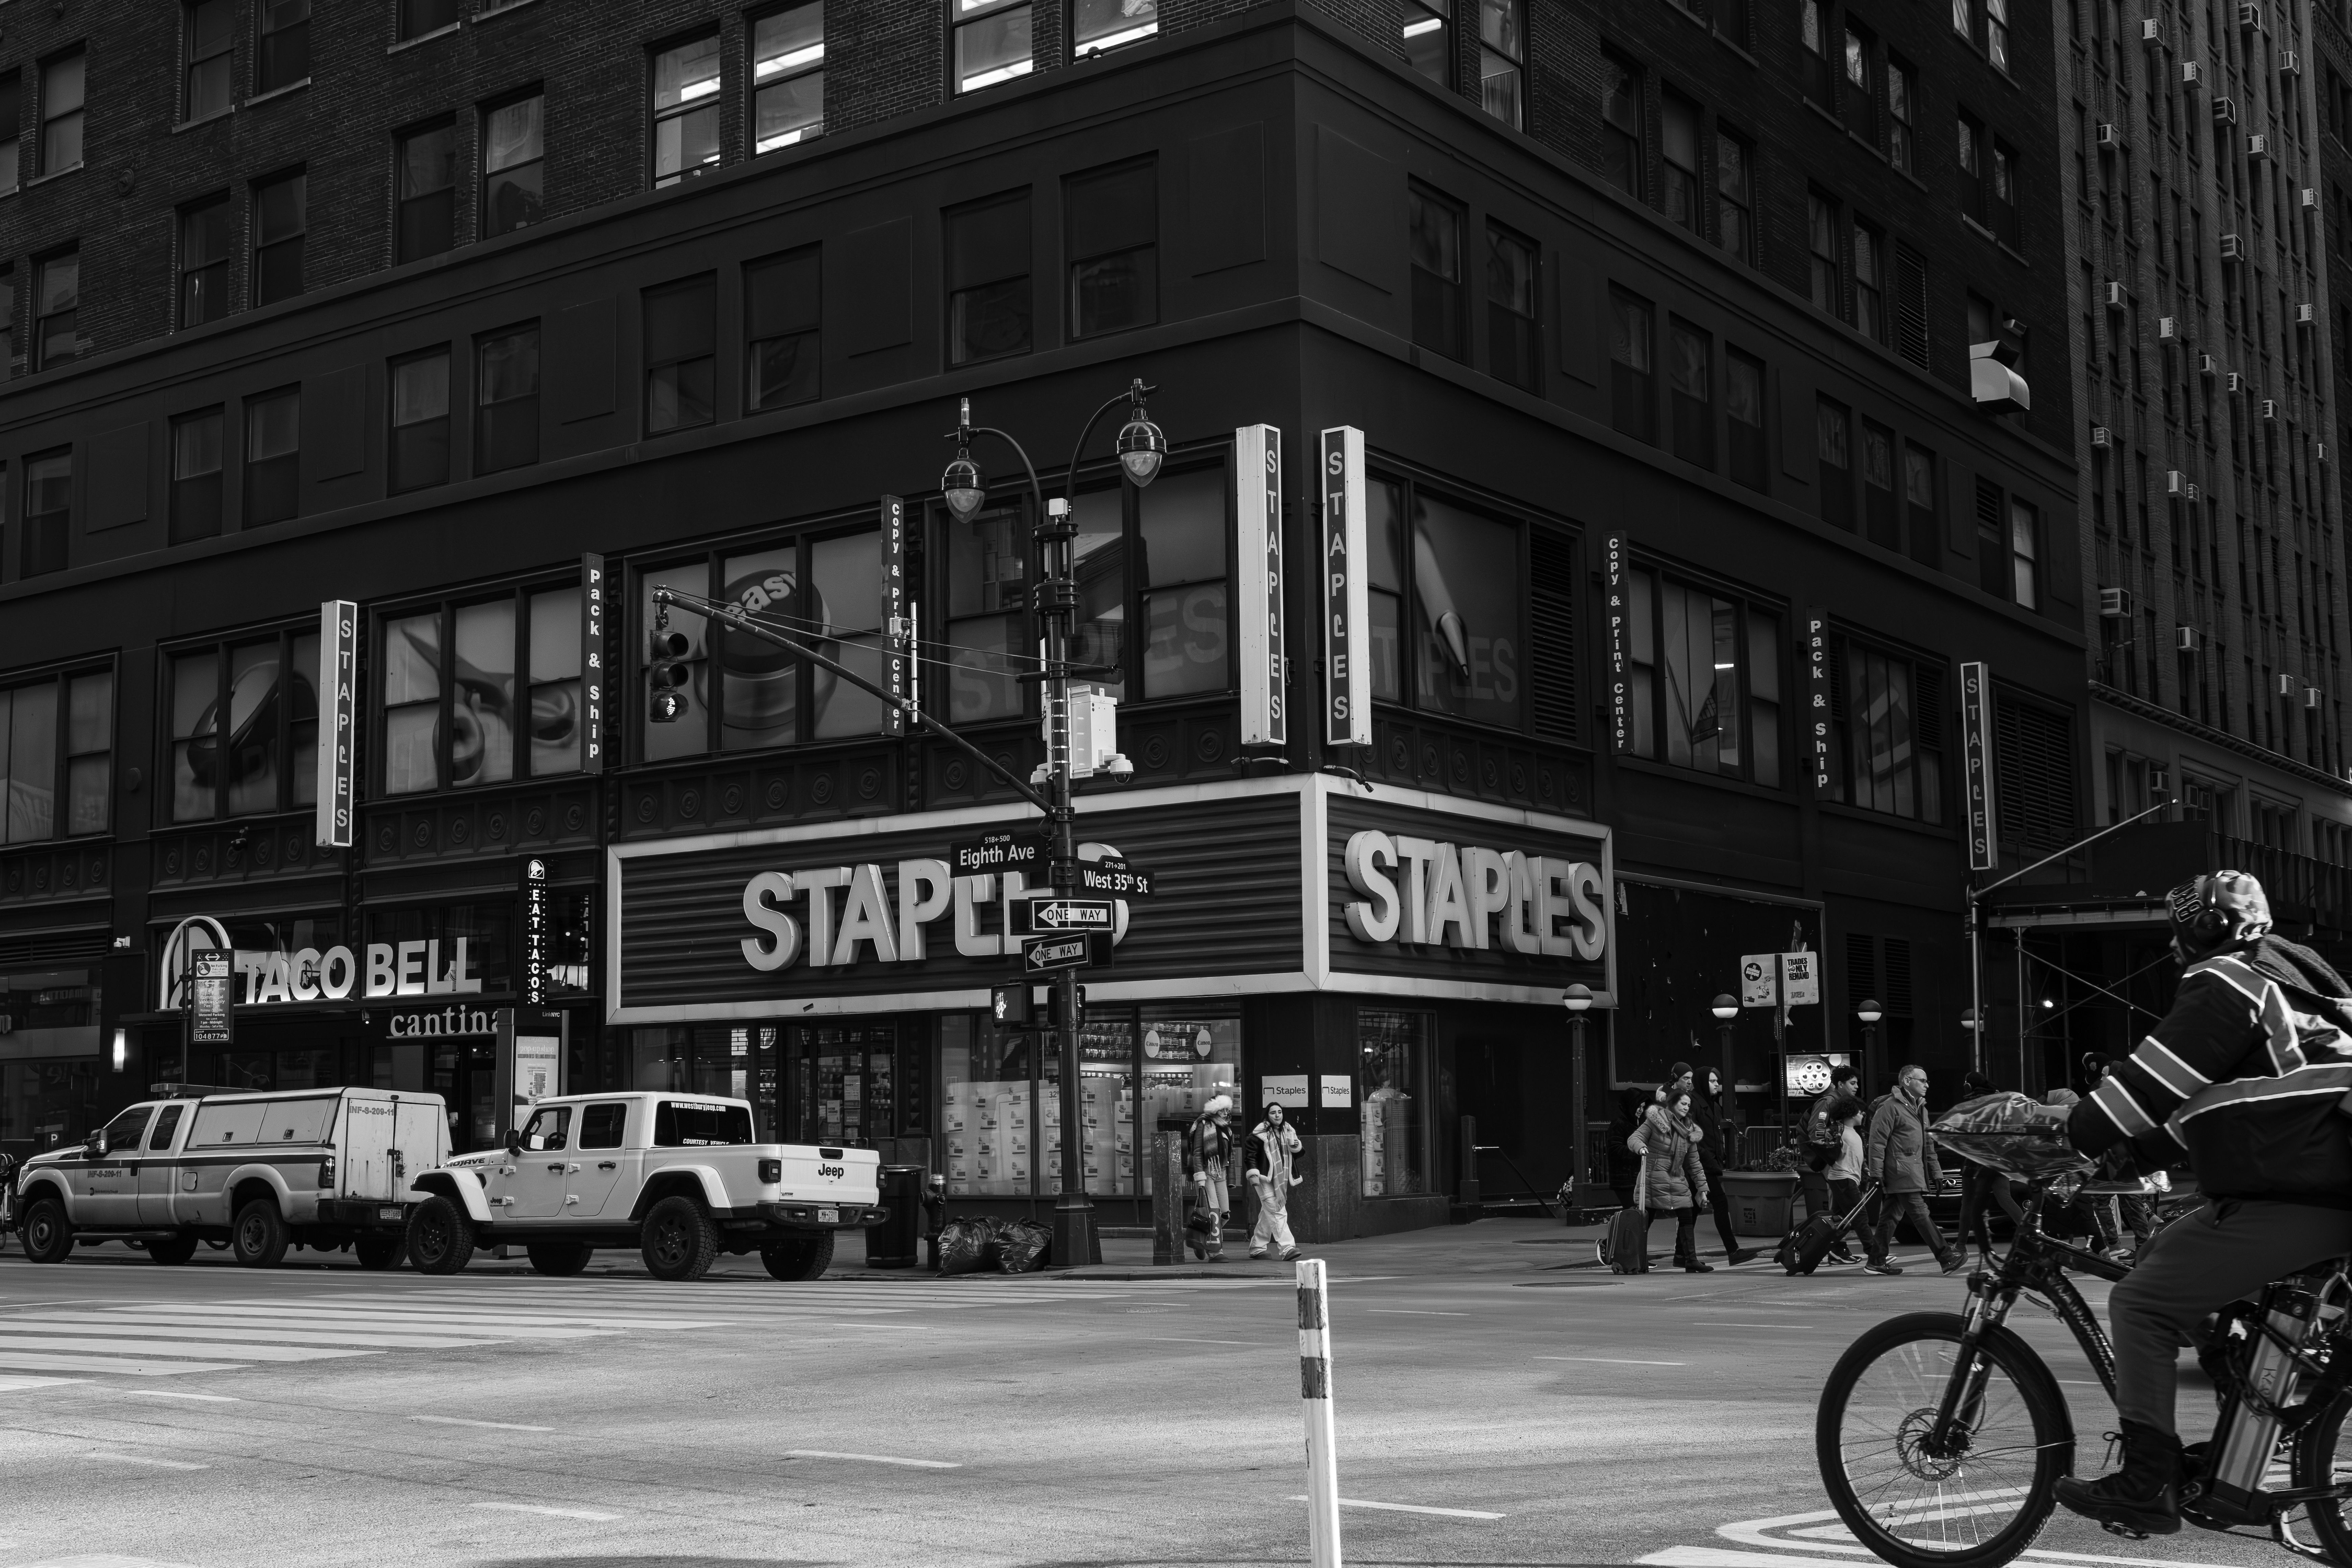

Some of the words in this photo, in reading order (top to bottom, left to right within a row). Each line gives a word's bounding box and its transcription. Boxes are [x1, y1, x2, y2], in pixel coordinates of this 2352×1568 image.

[892, 503, 900, 554] Copy
[891, 564, 900, 577] &
[1265, 449, 1281, 720] STAPLES
[1328, 451, 1348, 720] STAPLES
[1608, 538, 1619, 585] Copy
[589, 569, 601, 636] Pack
[892, 587, 900, 648] Prt
[1611, 595, 1621, 607] &
[589, 652, 601, 669] &
[1369, 626, 1516, 703] TPLES
[1611, 616, 1622, 673] Print
[1810, 620, 1823, 679] Pack
[892, 659, 901, 729] Cener
[1613, 684, 1625, 750] Center
[1813, 694, 1826, 708] &
[336, 619, 352, 827] STAPLES
[589, 685, 600, 759] Ship
[1815, 722, 1828, 789] Ship
[1966, 677, 1987, 855] STAPLES
[960, 845, 1003, 869] Eighth
[1008, 845, 1035, 861] Ave
[1084, 870, 1112, 890] West
[1114, 873, 1134, 891] 35th
[1137, 876, 1148, 893] St
[532, 889, 540, 928] EAT
[1047, 909, 1069, 920] ONE
[1080, 909, 1101, 920] WAY
[1344, 829, 1605, 962] STAPLES
[239, 945, 355, 1004] TACO
[366, 937, 482, 997] BELL
[531, 935, 540, 1003] TACOS
[1035, 948, 1052, 961] ONE
[1059, 944, 1078, 957] WAY
[1789, 972, 1809, 981] REMAND
[349, 1105, 394, 1116] INF-S-209-11
[671, 1102, 726, 1112] www.westburyjeep.com
[1276, 1087, 1306, 1096] Staples
[1330, 1087, 1350, 1096] Staples
[446, 1158, 486, 1168] MOJAVE
[818, 1163, 844, 1179] Jeep
